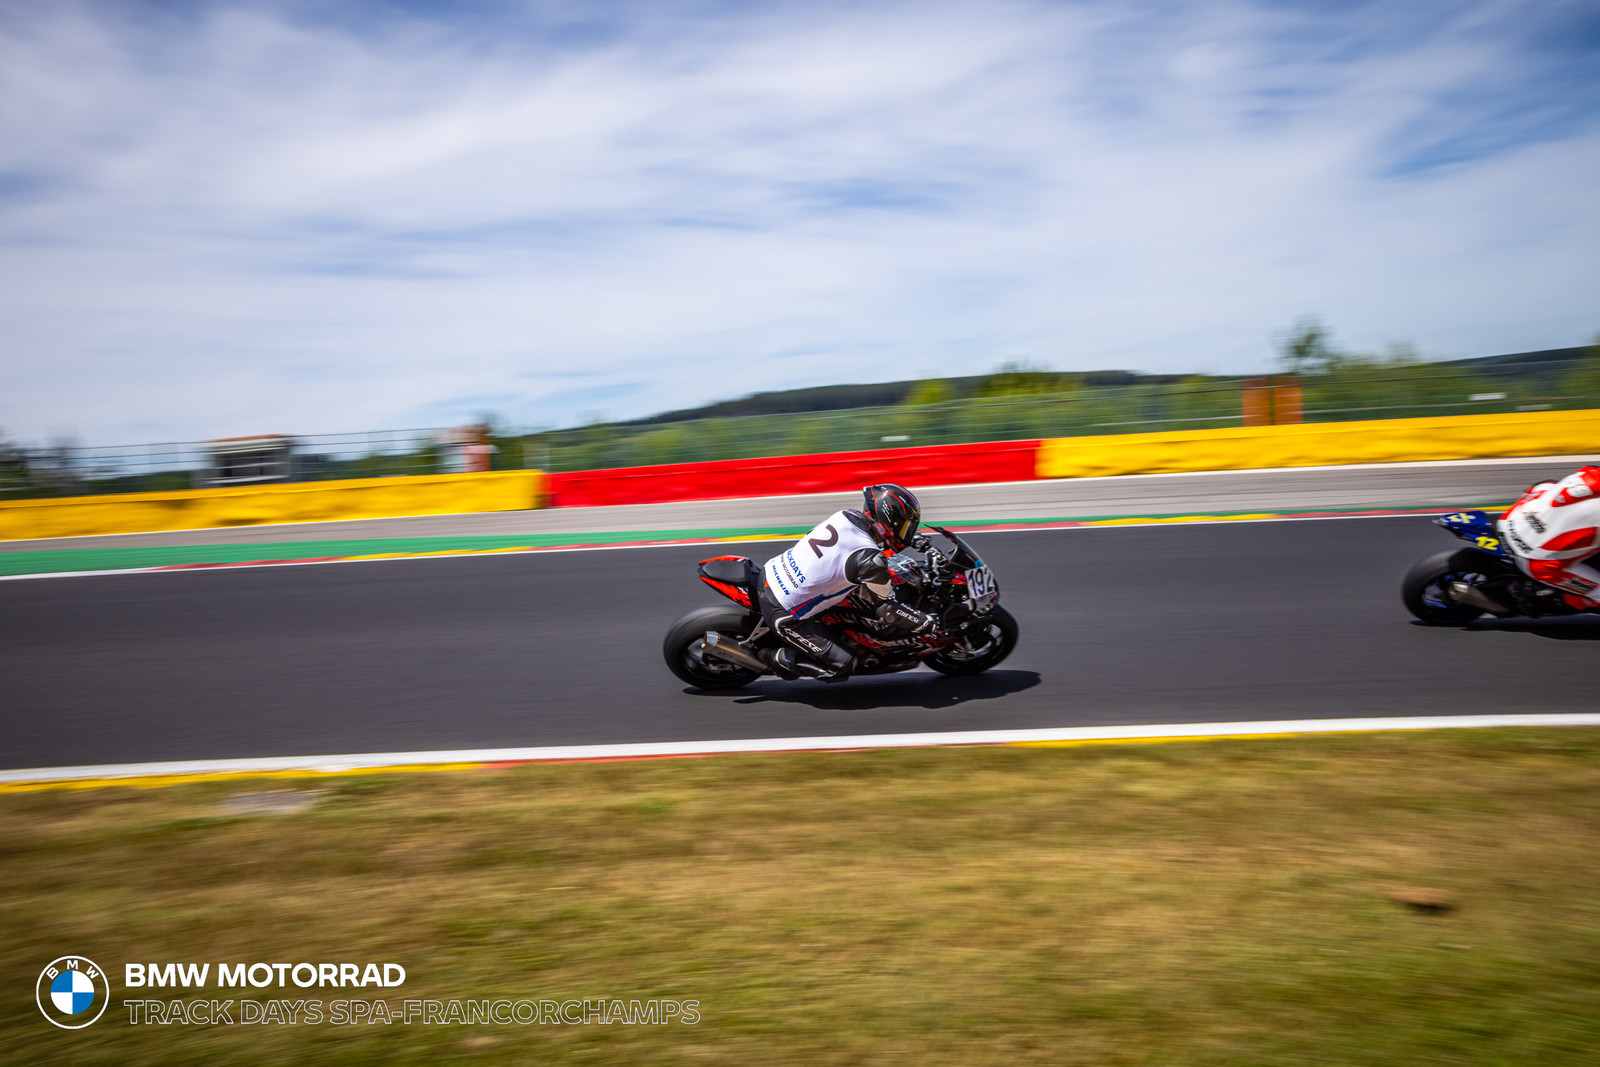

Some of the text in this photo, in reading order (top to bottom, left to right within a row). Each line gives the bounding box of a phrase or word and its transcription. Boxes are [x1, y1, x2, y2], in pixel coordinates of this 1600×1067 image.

[808, 524, 839, 559] 2
[1476, 536, 1500, 550] 12
[772, 565, 790, 595] MICHELIN
[783, 563, 799, 589] MOTORRAD
